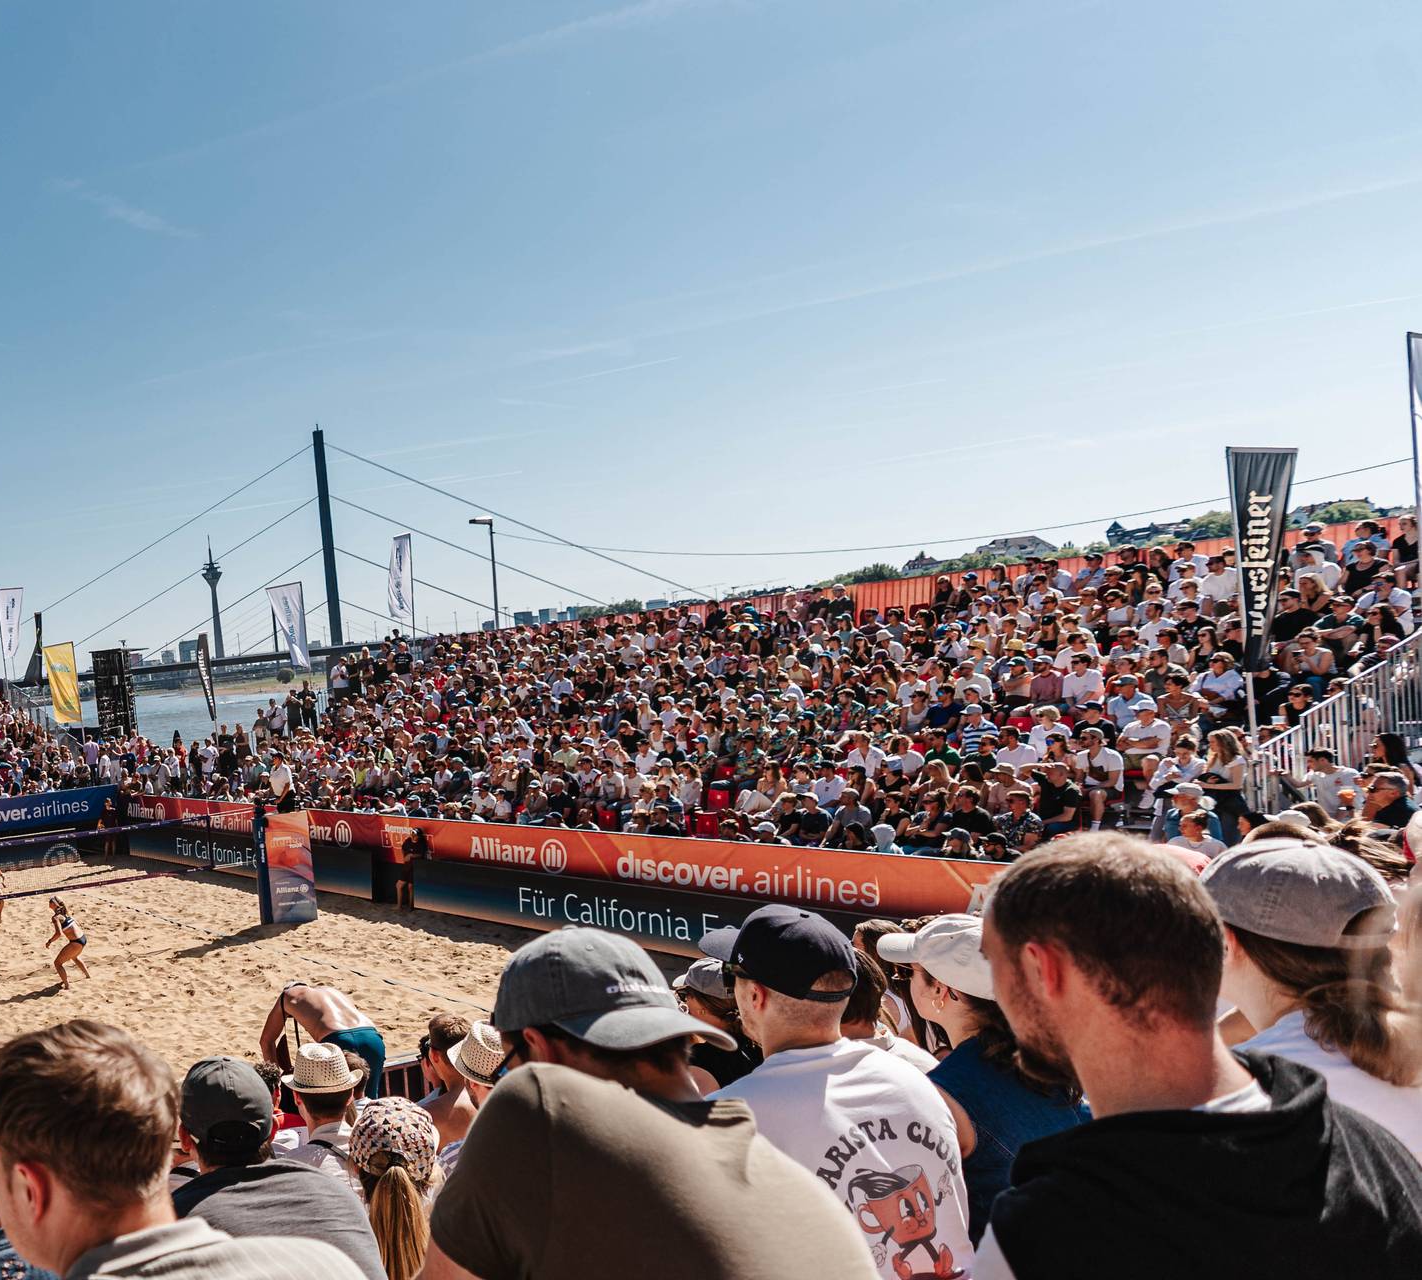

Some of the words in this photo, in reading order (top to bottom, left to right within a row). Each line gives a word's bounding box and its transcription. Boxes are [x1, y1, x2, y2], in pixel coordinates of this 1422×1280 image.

[128, 802, 154, 819] Allianz
[176, 837, 193, 857] Für
[194, 840, 243, 864] Calfornia
[470, 836, 536, 866] Allianz
[518, 887, 555, 919] Für
[563, 893, 692, 942] California
[816, 1118, 898, 1191] ARISTA
[906, 1121, 959, 1177] CLUB
